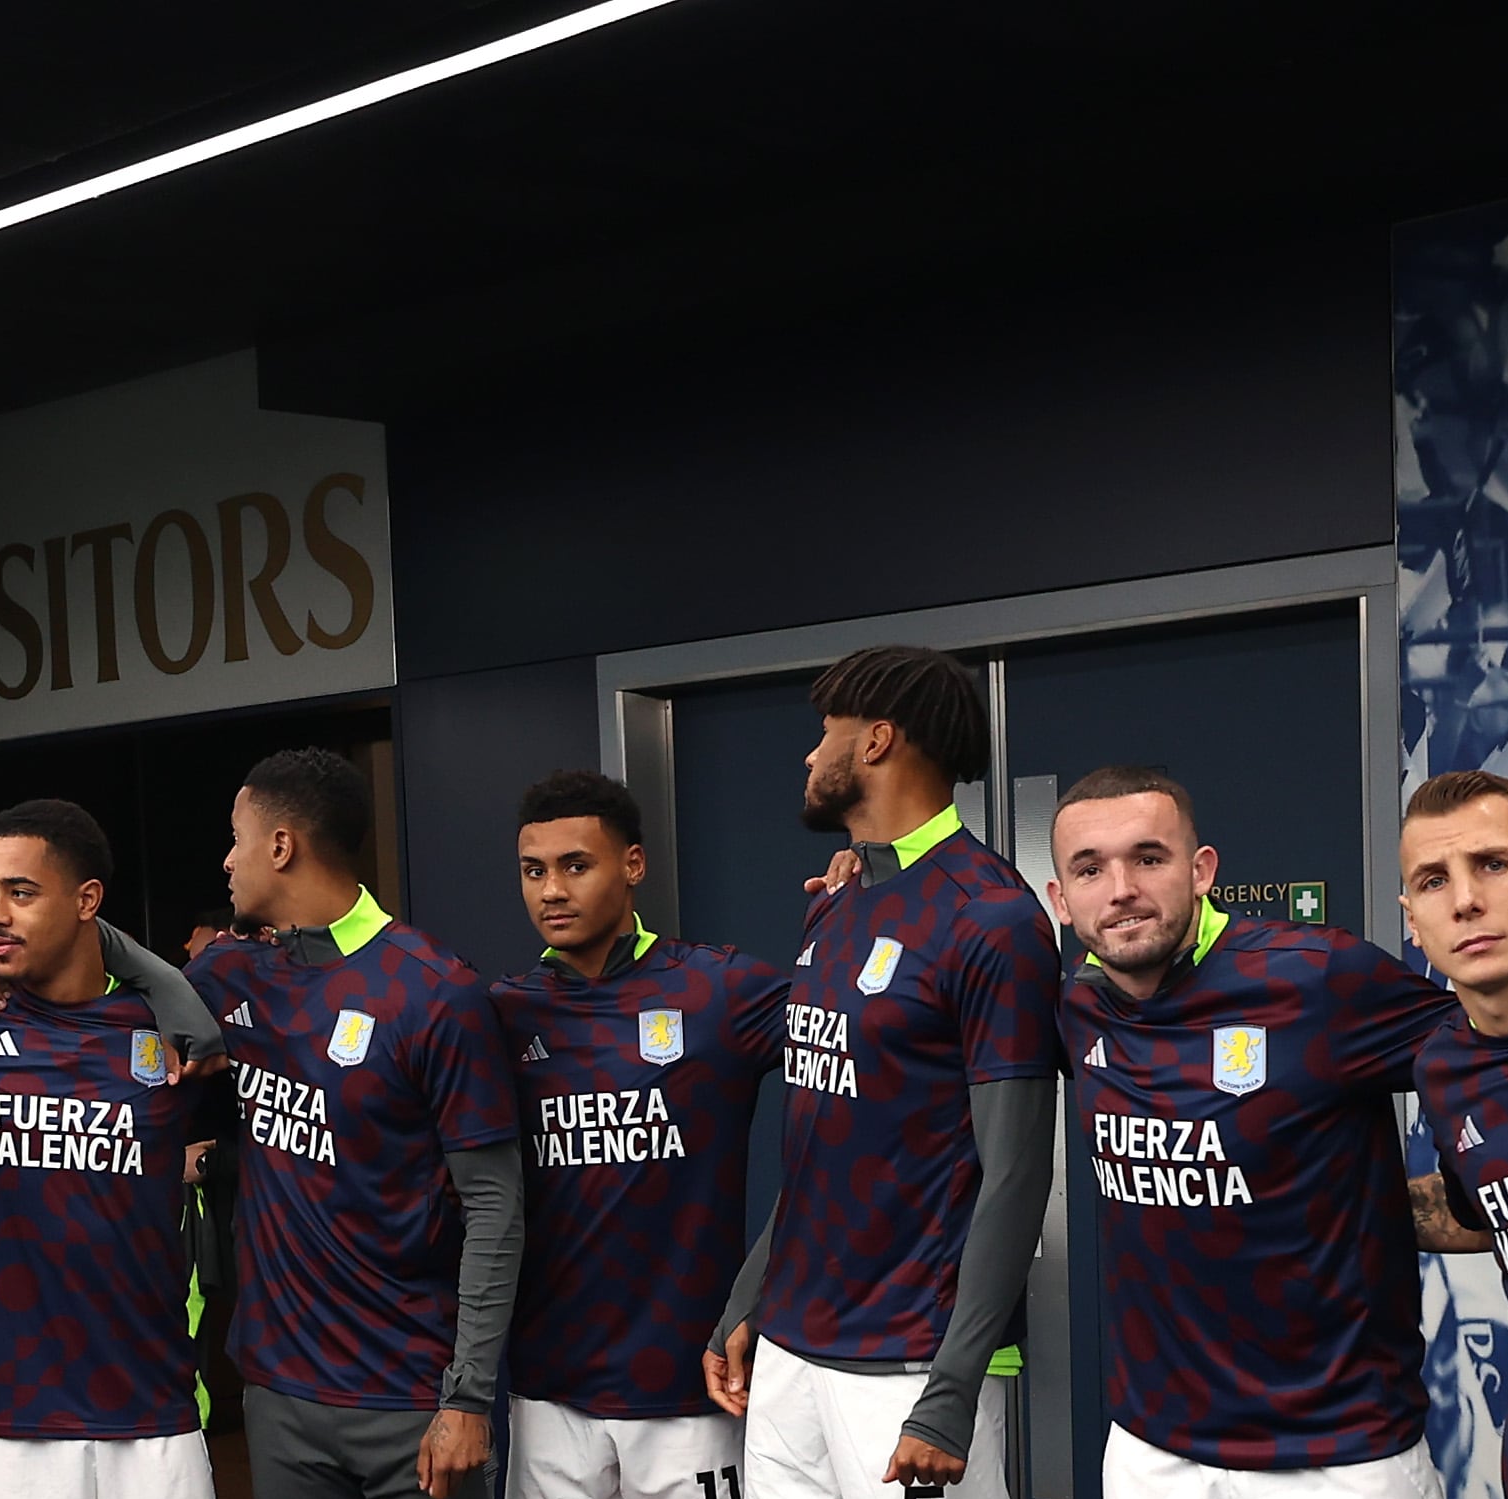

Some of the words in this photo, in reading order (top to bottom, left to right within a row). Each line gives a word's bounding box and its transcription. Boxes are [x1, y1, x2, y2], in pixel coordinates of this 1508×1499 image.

[1211, 883, 1290, 903] RGENCY
[541, 1087, 669, 1132] FUERZA
[533, 1125, 686, 1167] VALENCIA
[1094, 1113, 1226, 1162] FUERZA
[1091, 1156, 1253, 1206] VALENCIA
